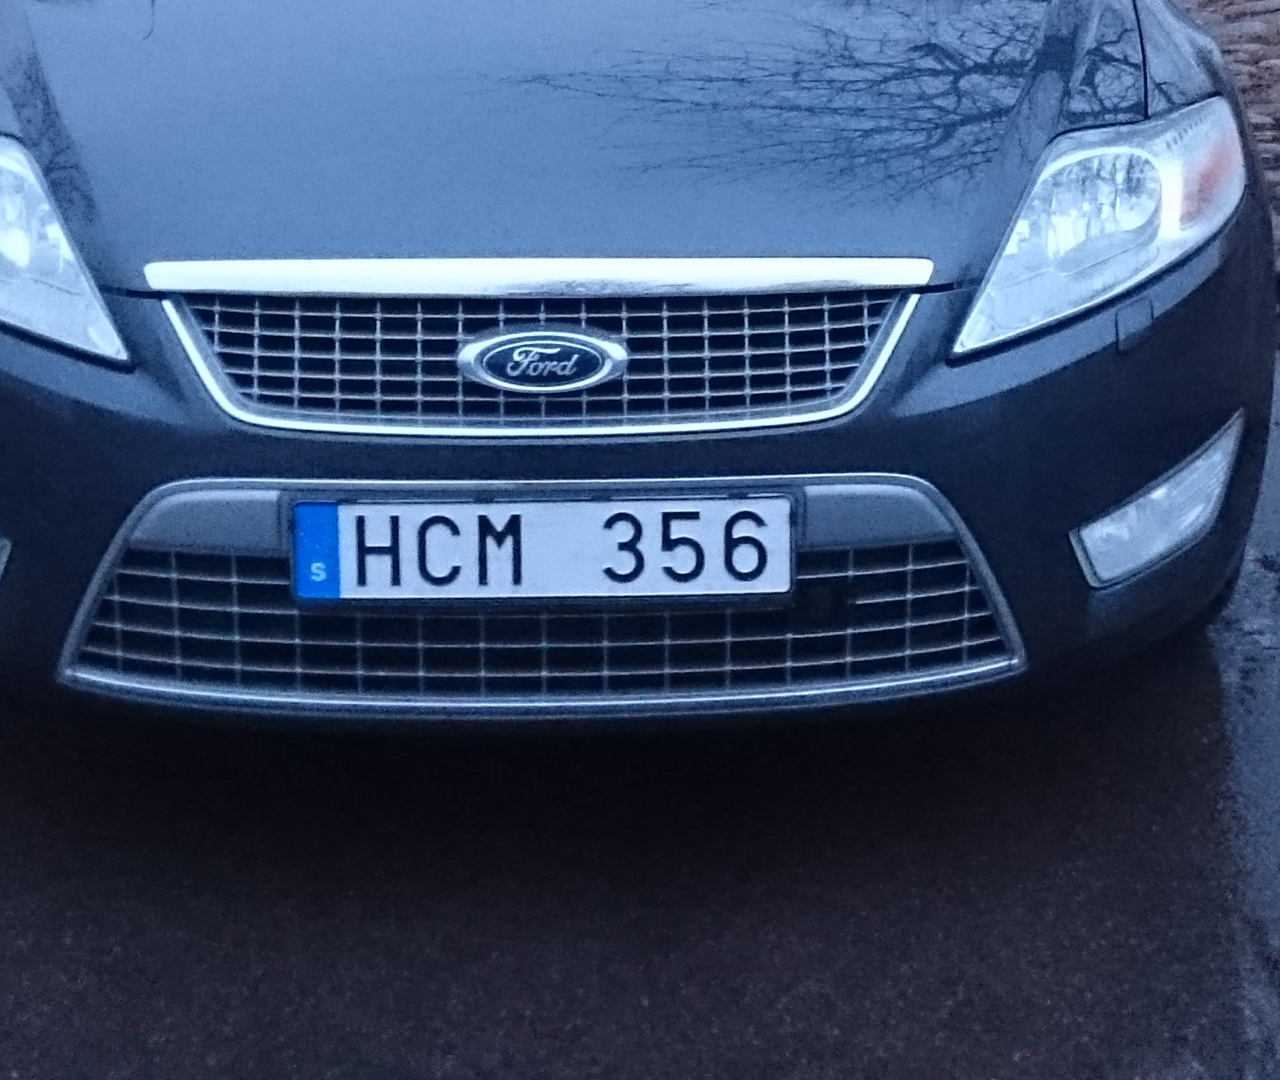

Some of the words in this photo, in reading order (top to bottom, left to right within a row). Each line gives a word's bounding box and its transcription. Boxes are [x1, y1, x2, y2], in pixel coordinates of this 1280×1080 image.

[506, 347, 579, 377] Ford
[355, 513, 522, 588] HCM
[601, 510, 769, 584] 356
[310, 562, 327, 583] S
